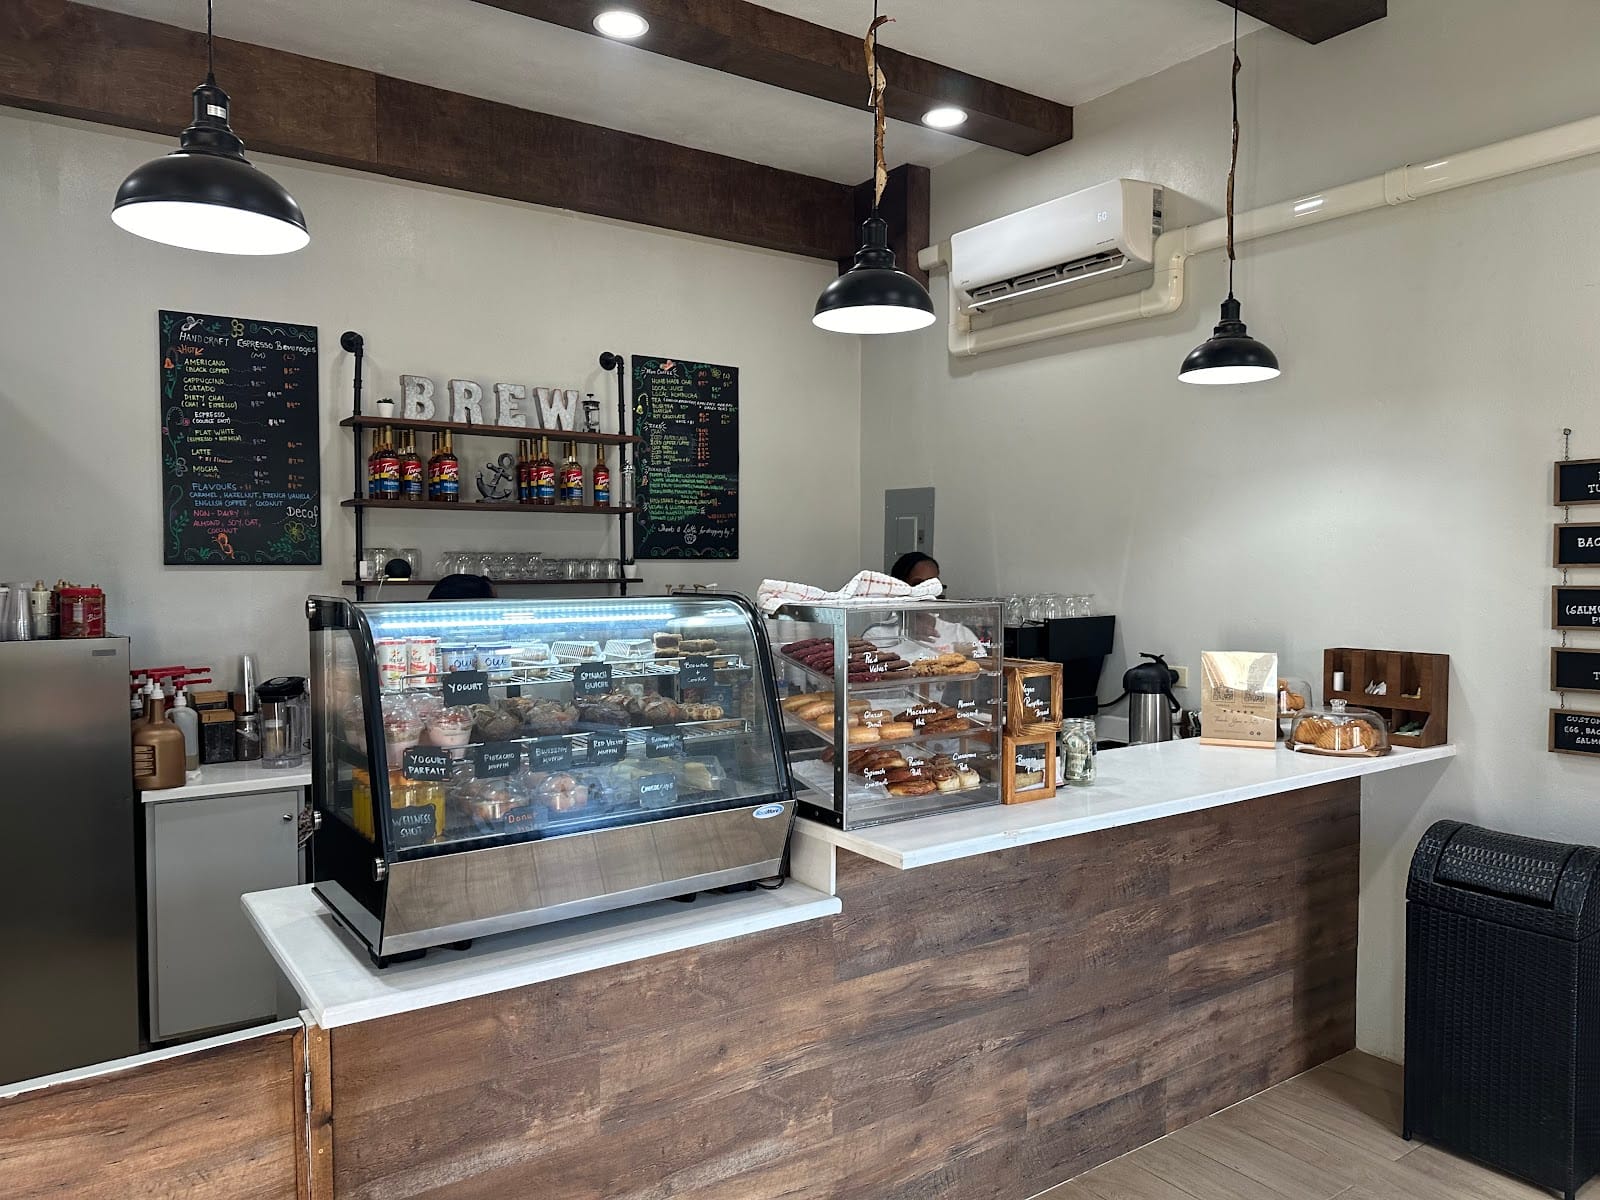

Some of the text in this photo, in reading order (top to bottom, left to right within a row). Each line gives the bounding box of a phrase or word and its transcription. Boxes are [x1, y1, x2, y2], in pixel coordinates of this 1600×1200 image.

[184, 358, 226, 366] AMERICANO
[400, 374, 579, 432] BREW
[192, 482, 237, 490] FLAVOURS
[286, 505, 318, 528] Decaf
[864, 651, 878, 664] Red
[870, 662, 888, 673] Velvet
[580, 670, 608, 682] SPINACH
[448, 682, 484, 694] YOGURT
[906, 708, 936, 716] Macadamia
[593, 740, 605, 748] RED
[1575, 737, 1600, 745] SALM
[410, 754, 448, 765] YOGURT
[408, 766, 446, 776] PARFAIT
[391, 812, 432, 826] WELLNESS
[400, 826, 423, 838] SHOT
